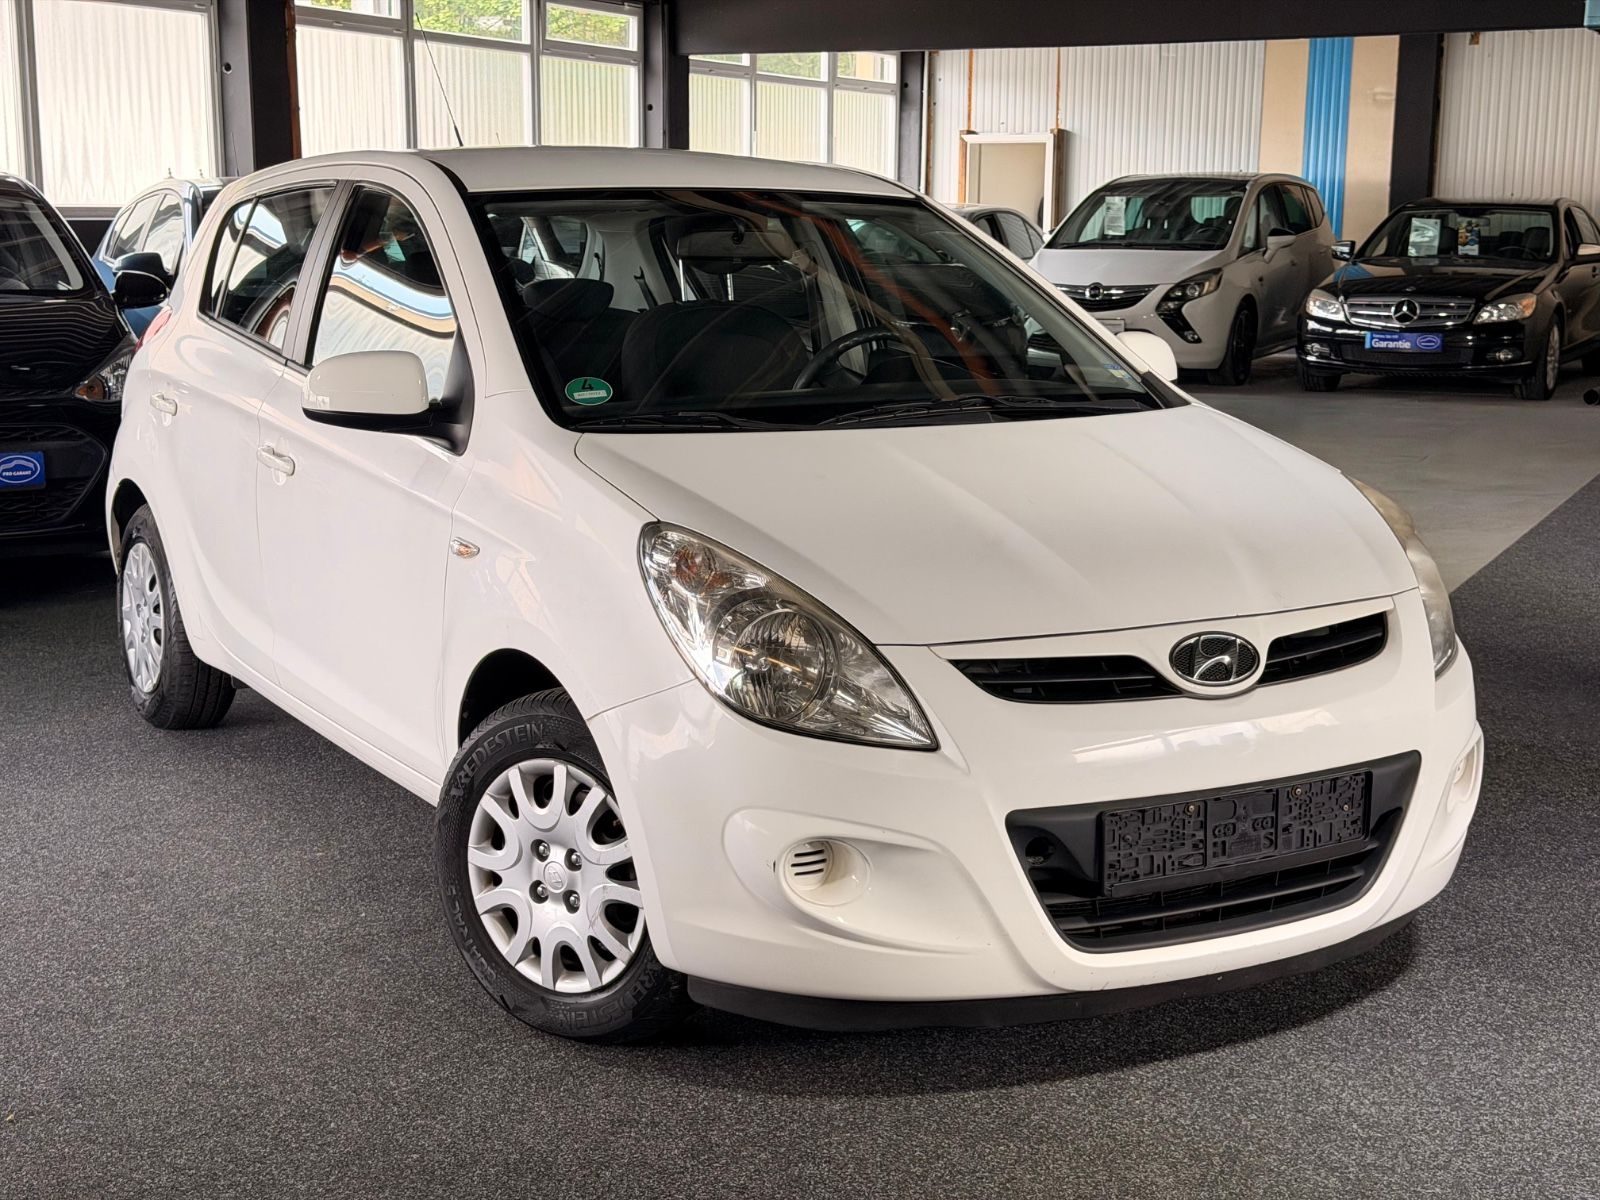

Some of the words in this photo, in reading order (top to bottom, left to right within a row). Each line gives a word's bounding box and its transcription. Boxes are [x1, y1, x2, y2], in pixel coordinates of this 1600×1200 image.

[1372, 339, 1411, 349] Garantie
[582, 379, 594, 391] 4
[450, 723, 544, 797] VREDESTEIN
